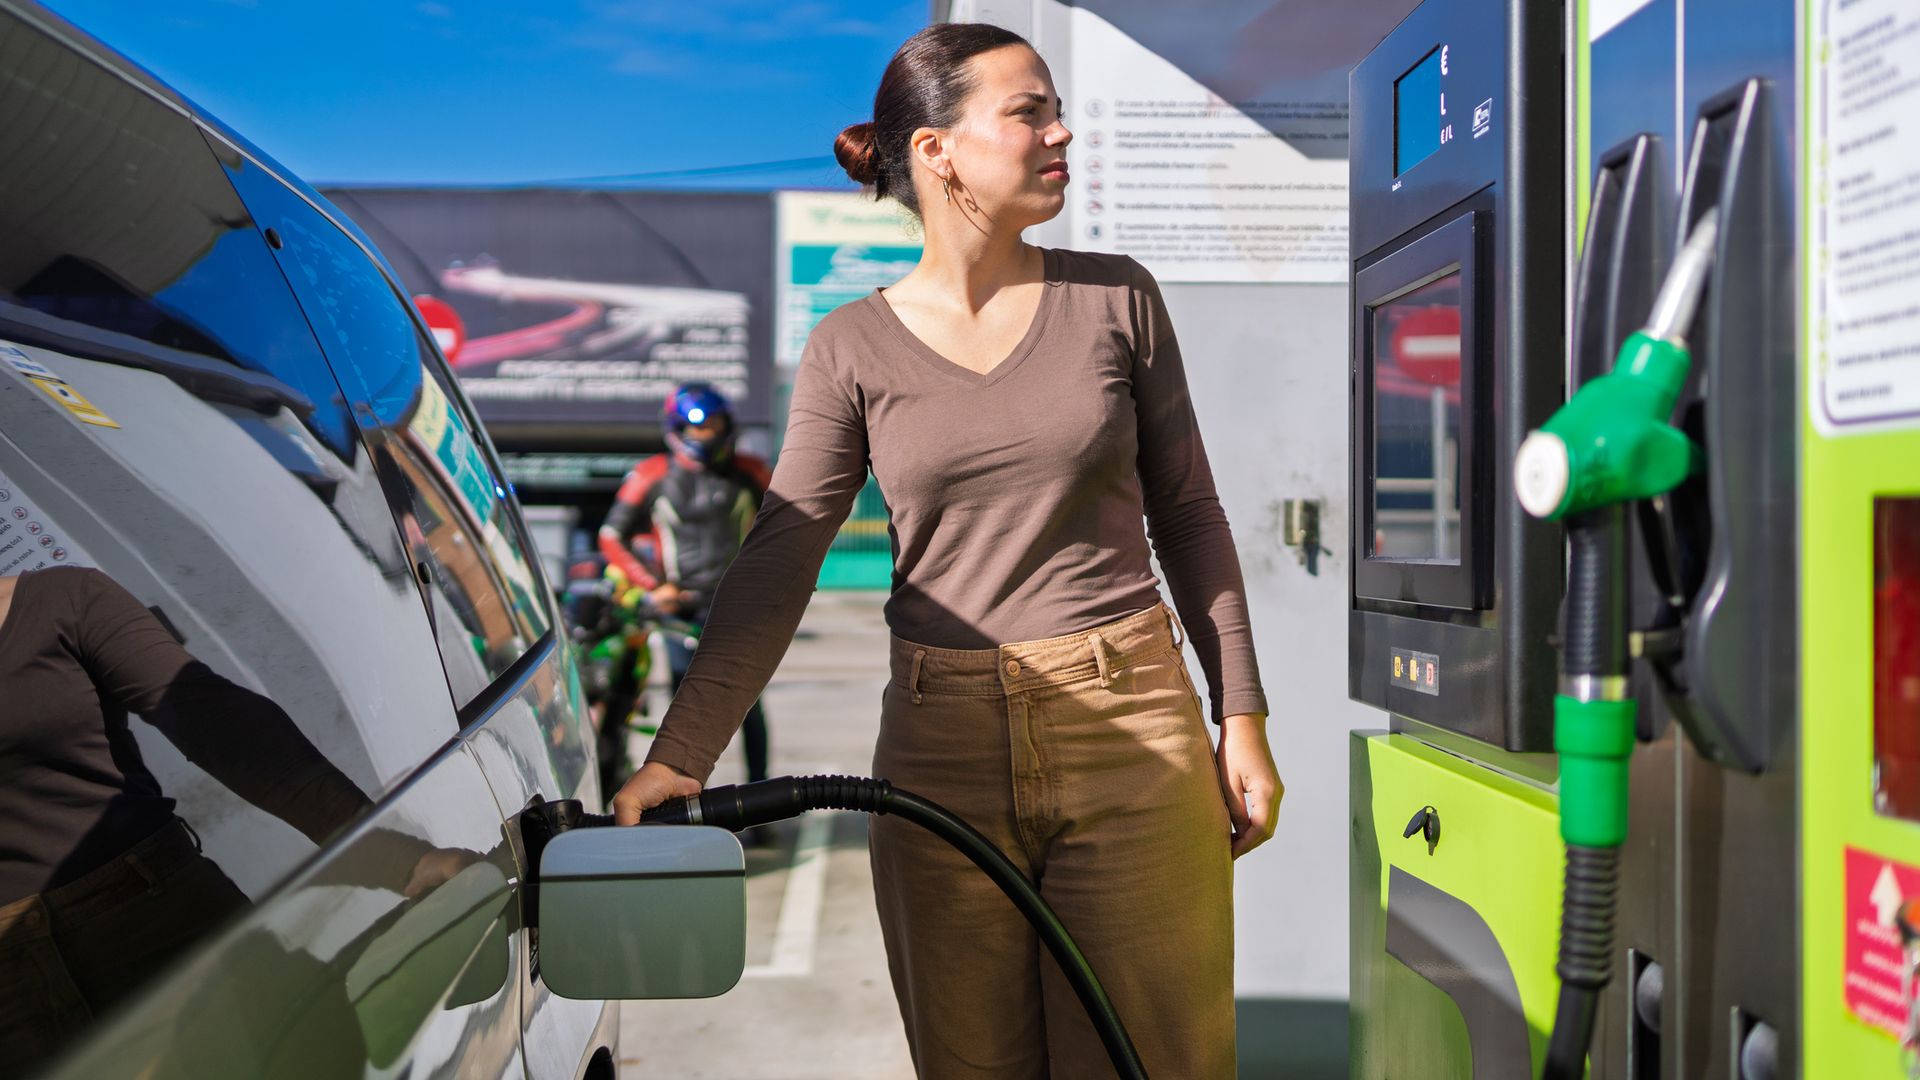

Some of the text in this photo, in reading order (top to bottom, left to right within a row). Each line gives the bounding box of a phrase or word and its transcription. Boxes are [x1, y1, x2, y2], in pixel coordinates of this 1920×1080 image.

[1440, 44, 1449, 76] €
[1440, 92, 1447, 115] L
[1441, 124, 1453, 144] €/L
